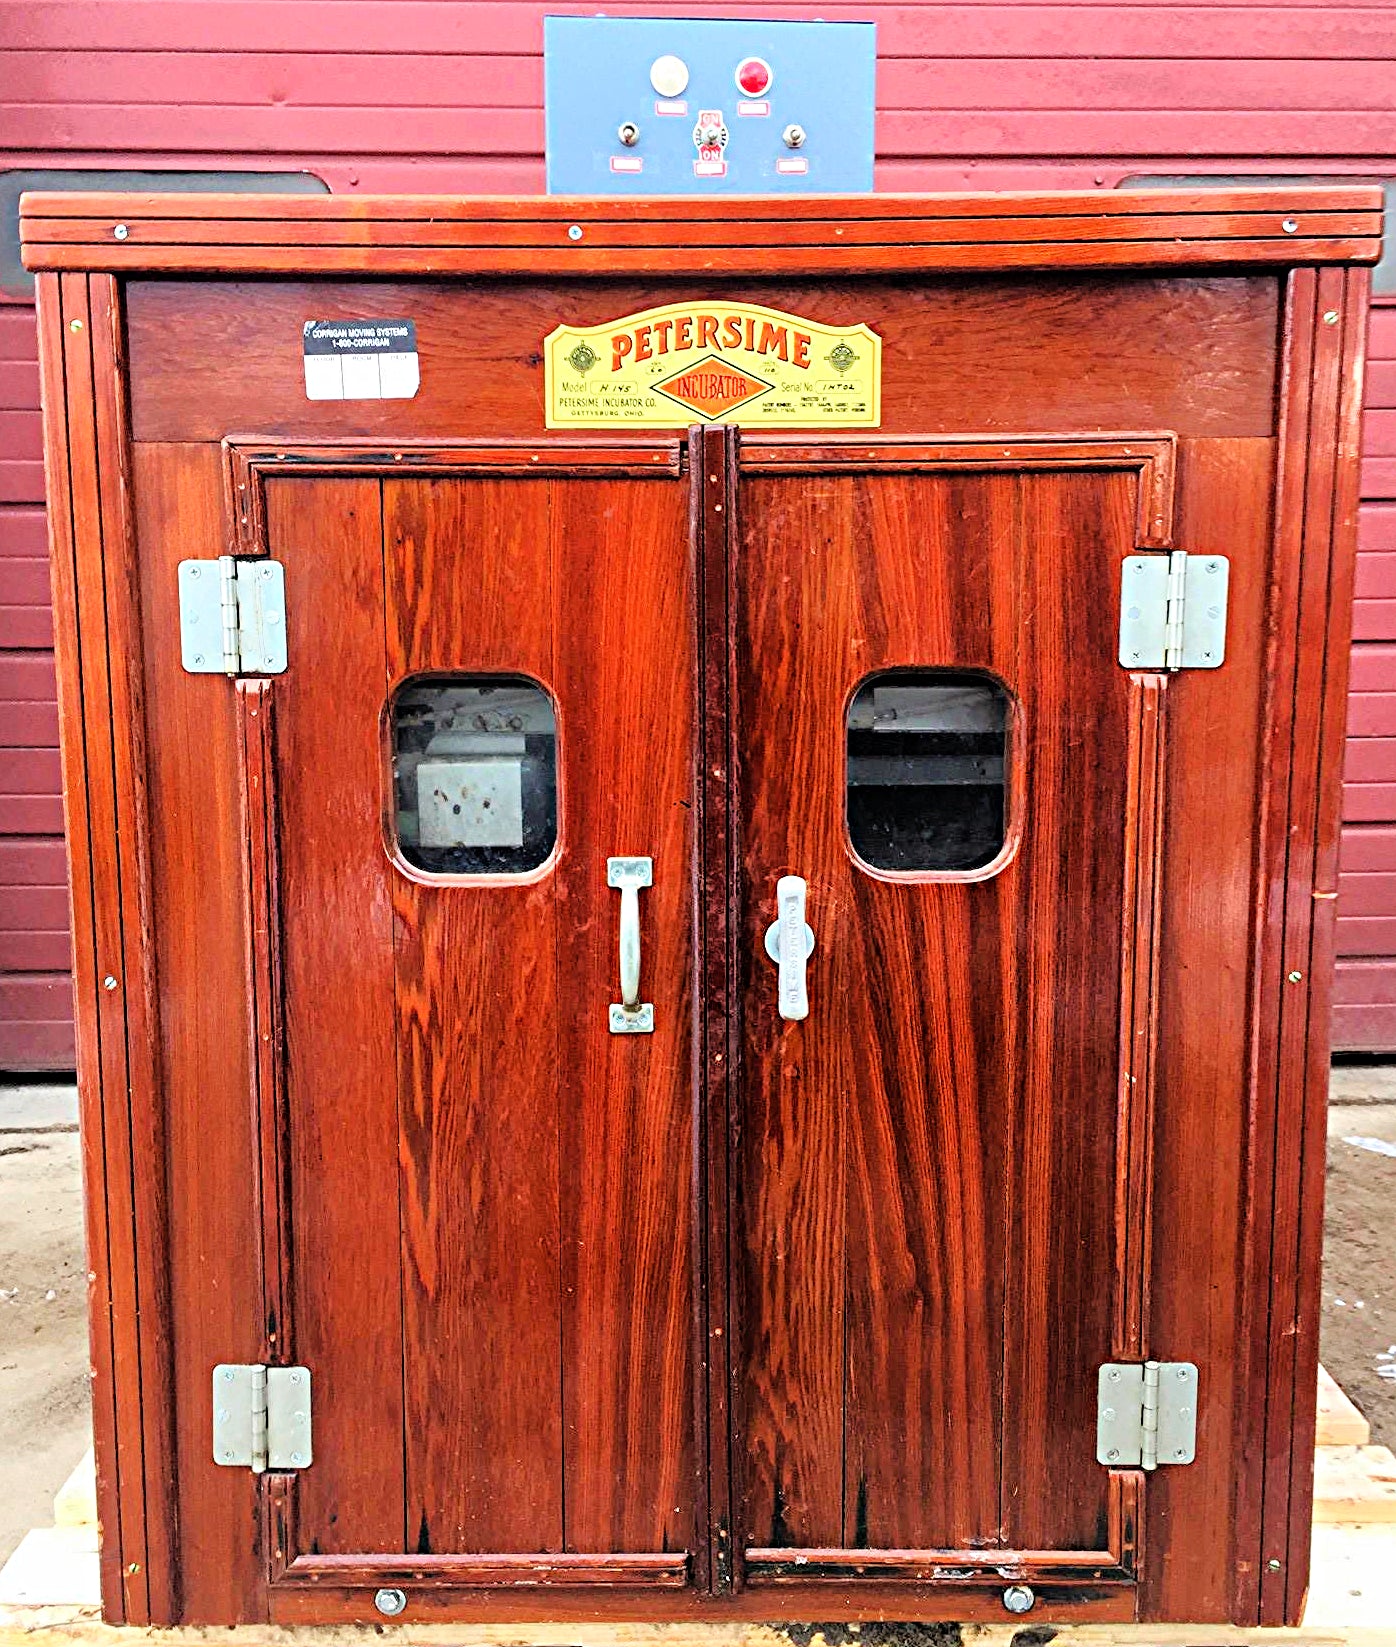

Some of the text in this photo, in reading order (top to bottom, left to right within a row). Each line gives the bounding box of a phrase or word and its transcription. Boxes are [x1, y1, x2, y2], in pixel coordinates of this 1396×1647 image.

[702, 150, 719, 160] ON
[312, 326, 409, 339] CORRIGAN MOVING SYSTEMS
[331, 338, 390, 348] 1-800-CORRIGAN
[610, 315, 812, 372] PETERSIME
[561, 381, 588, 393] Model
[676, 373, 748, 400] INCUBATOR
[781, 381, 802, 393] Serial
[559, 397, 657, 408] PETERSIME INCUBATOR CO.
